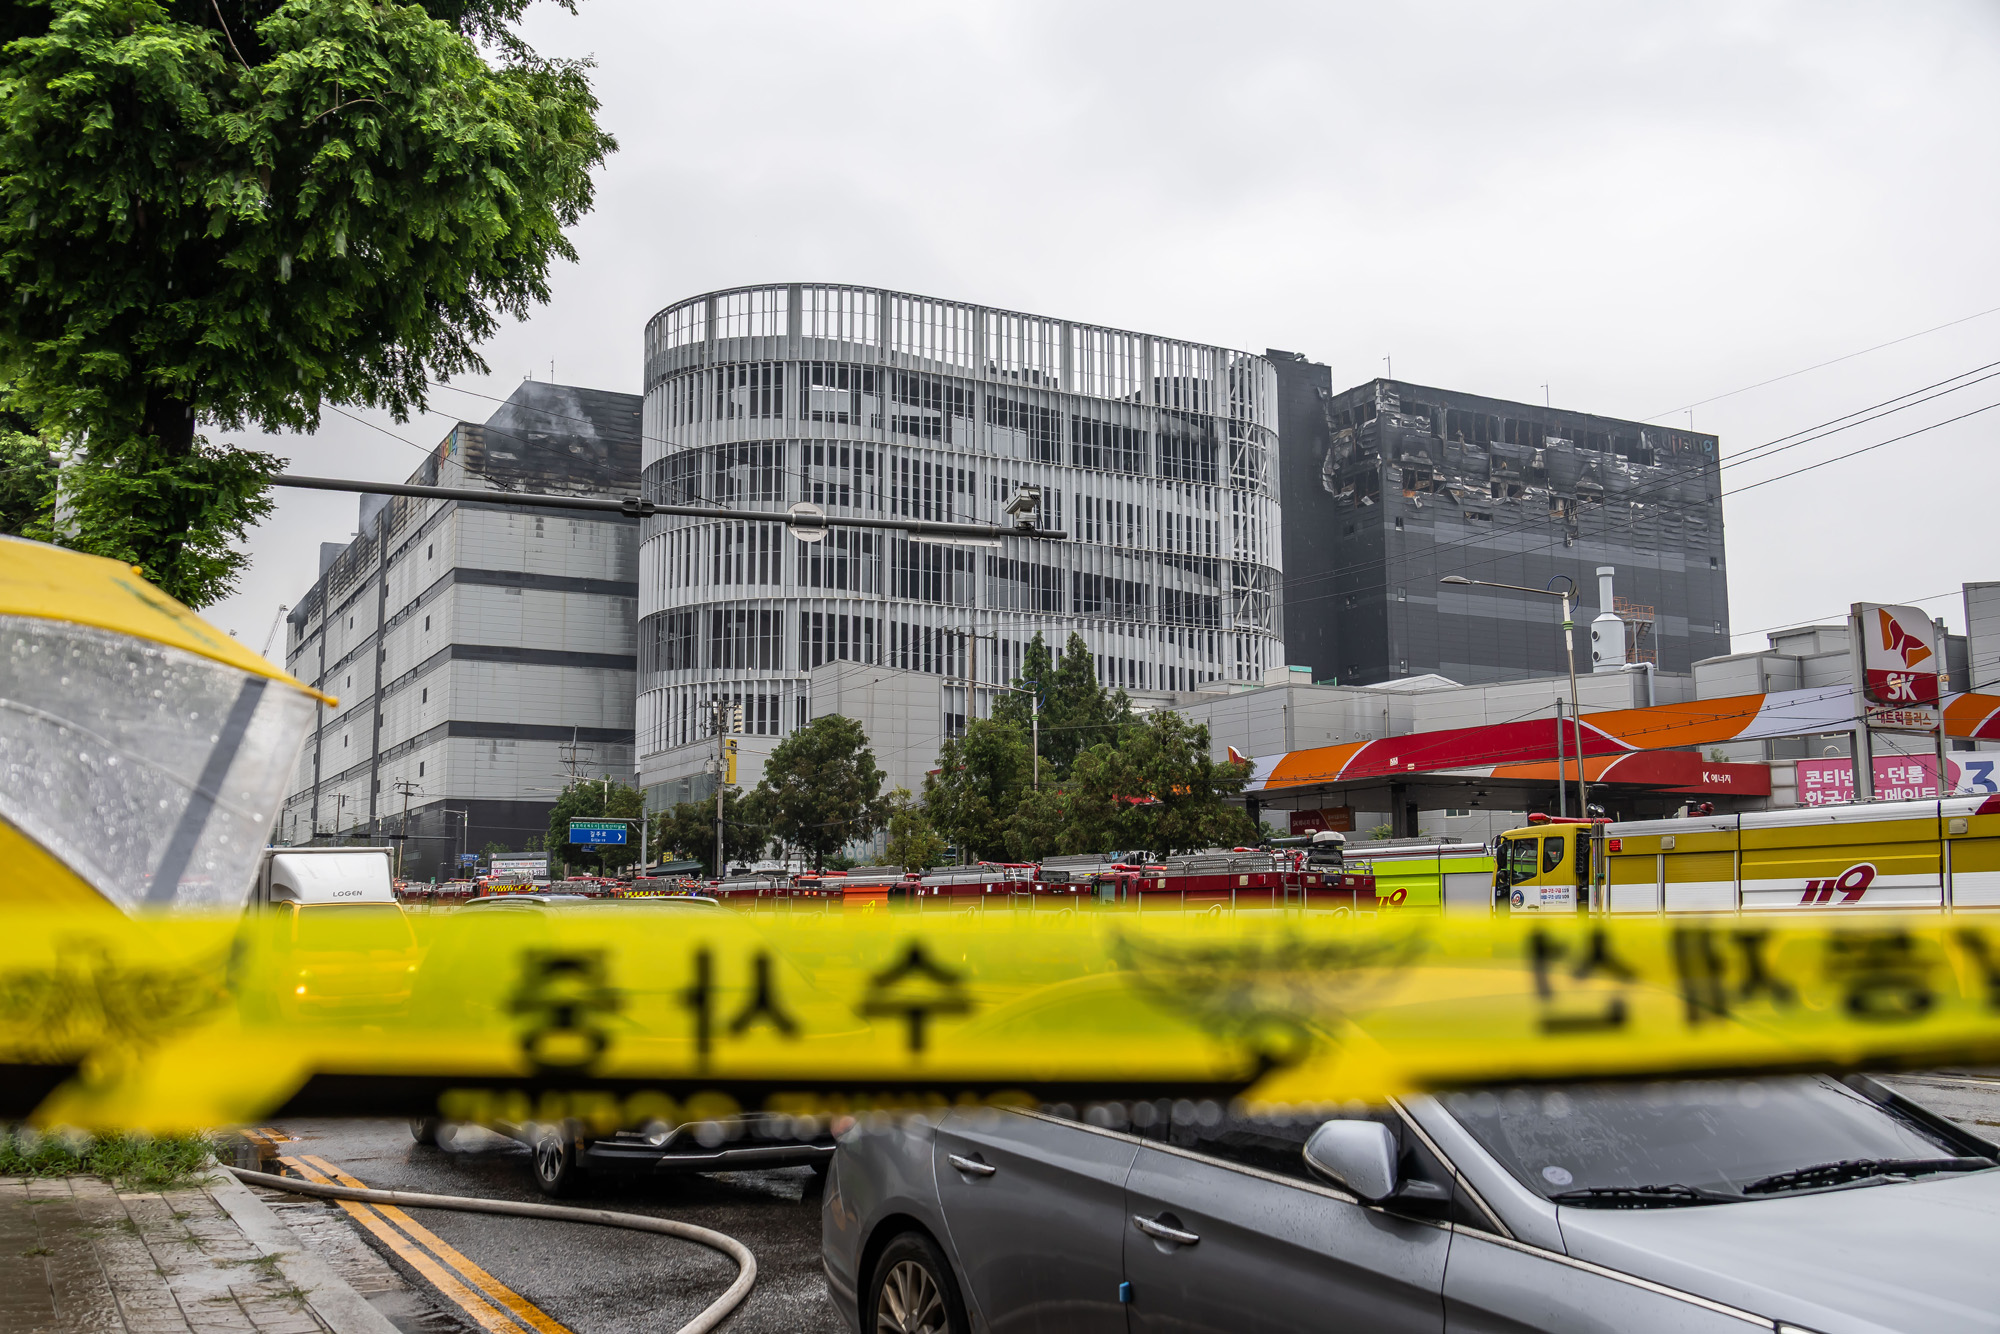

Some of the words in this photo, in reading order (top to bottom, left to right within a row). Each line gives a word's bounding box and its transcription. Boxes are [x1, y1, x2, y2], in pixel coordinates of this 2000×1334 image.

[1886, 672, 1917, 701] SK
[1805, 765, 1925, 788] 콘티넨·던롭
[332, 890, 363, 898] LOGEN
[1797, 863, 1877, 906] 119
